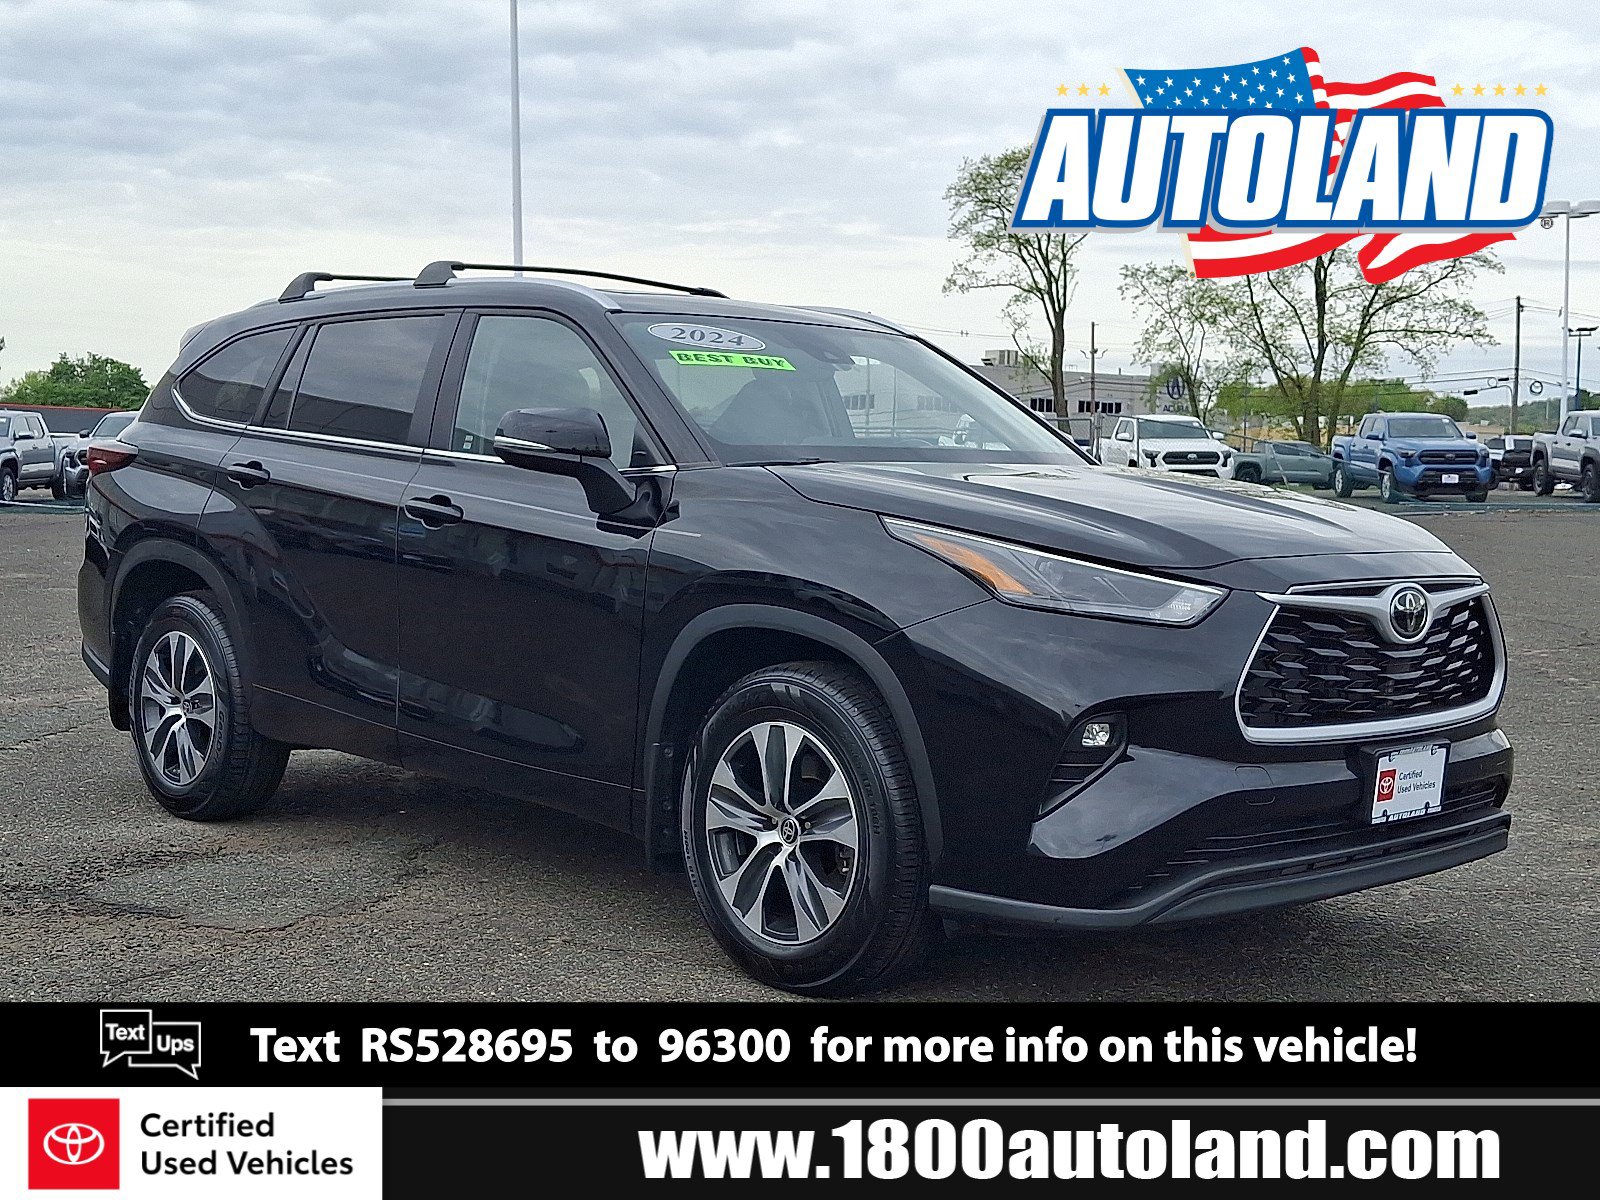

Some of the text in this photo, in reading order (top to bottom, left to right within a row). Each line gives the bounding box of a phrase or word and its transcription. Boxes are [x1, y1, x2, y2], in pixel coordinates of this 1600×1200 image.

[671, 327, 744, 346] 2024
[677, 353, 786, 368] BEST BUY
[1399, 770, 1423, 781] Certified
[1397, 781, 1436, 794] Used Vehicles
[1388, 809, 1426, 821] AUTOLAND
